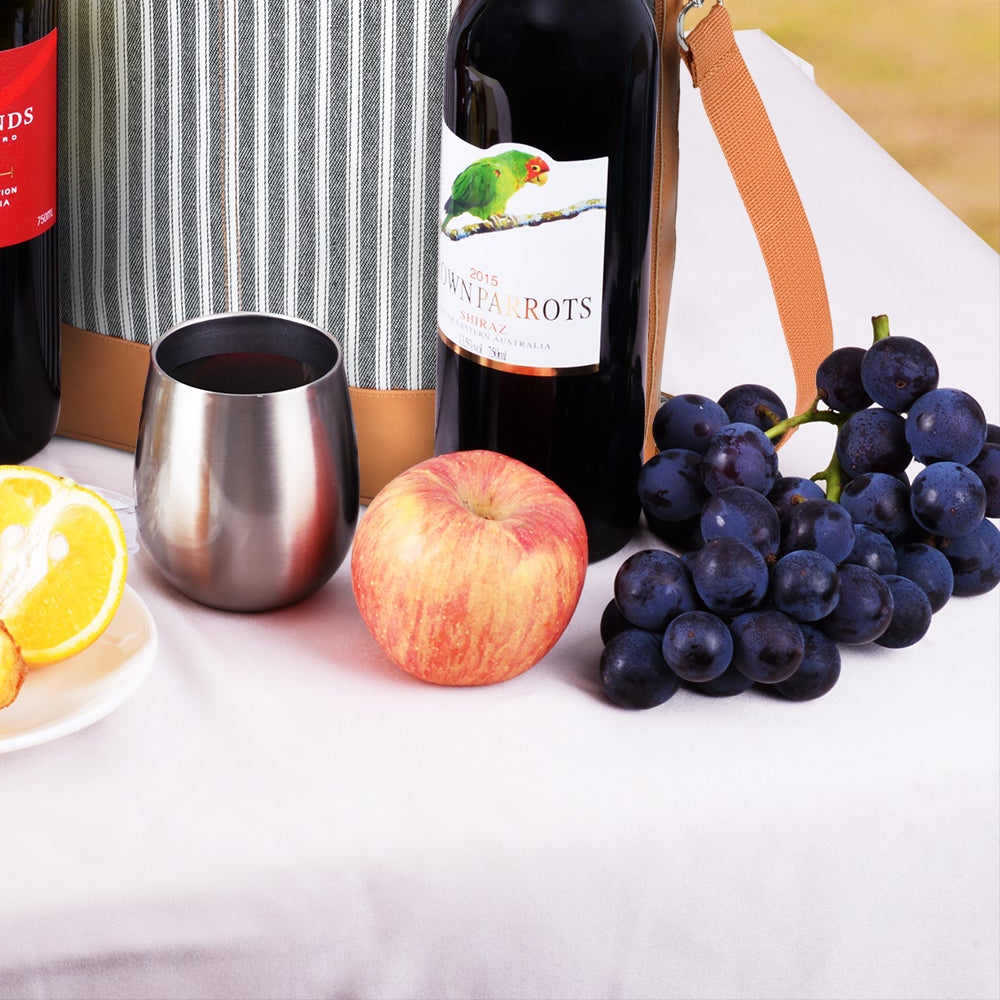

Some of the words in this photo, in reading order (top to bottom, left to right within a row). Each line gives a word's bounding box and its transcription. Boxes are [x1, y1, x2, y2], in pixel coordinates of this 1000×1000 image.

[469, 267, 499, 287] 2015
[460, 311, 508, 335] SHIRAZ
[494, 336, 551, 350] AUSTRALIA
